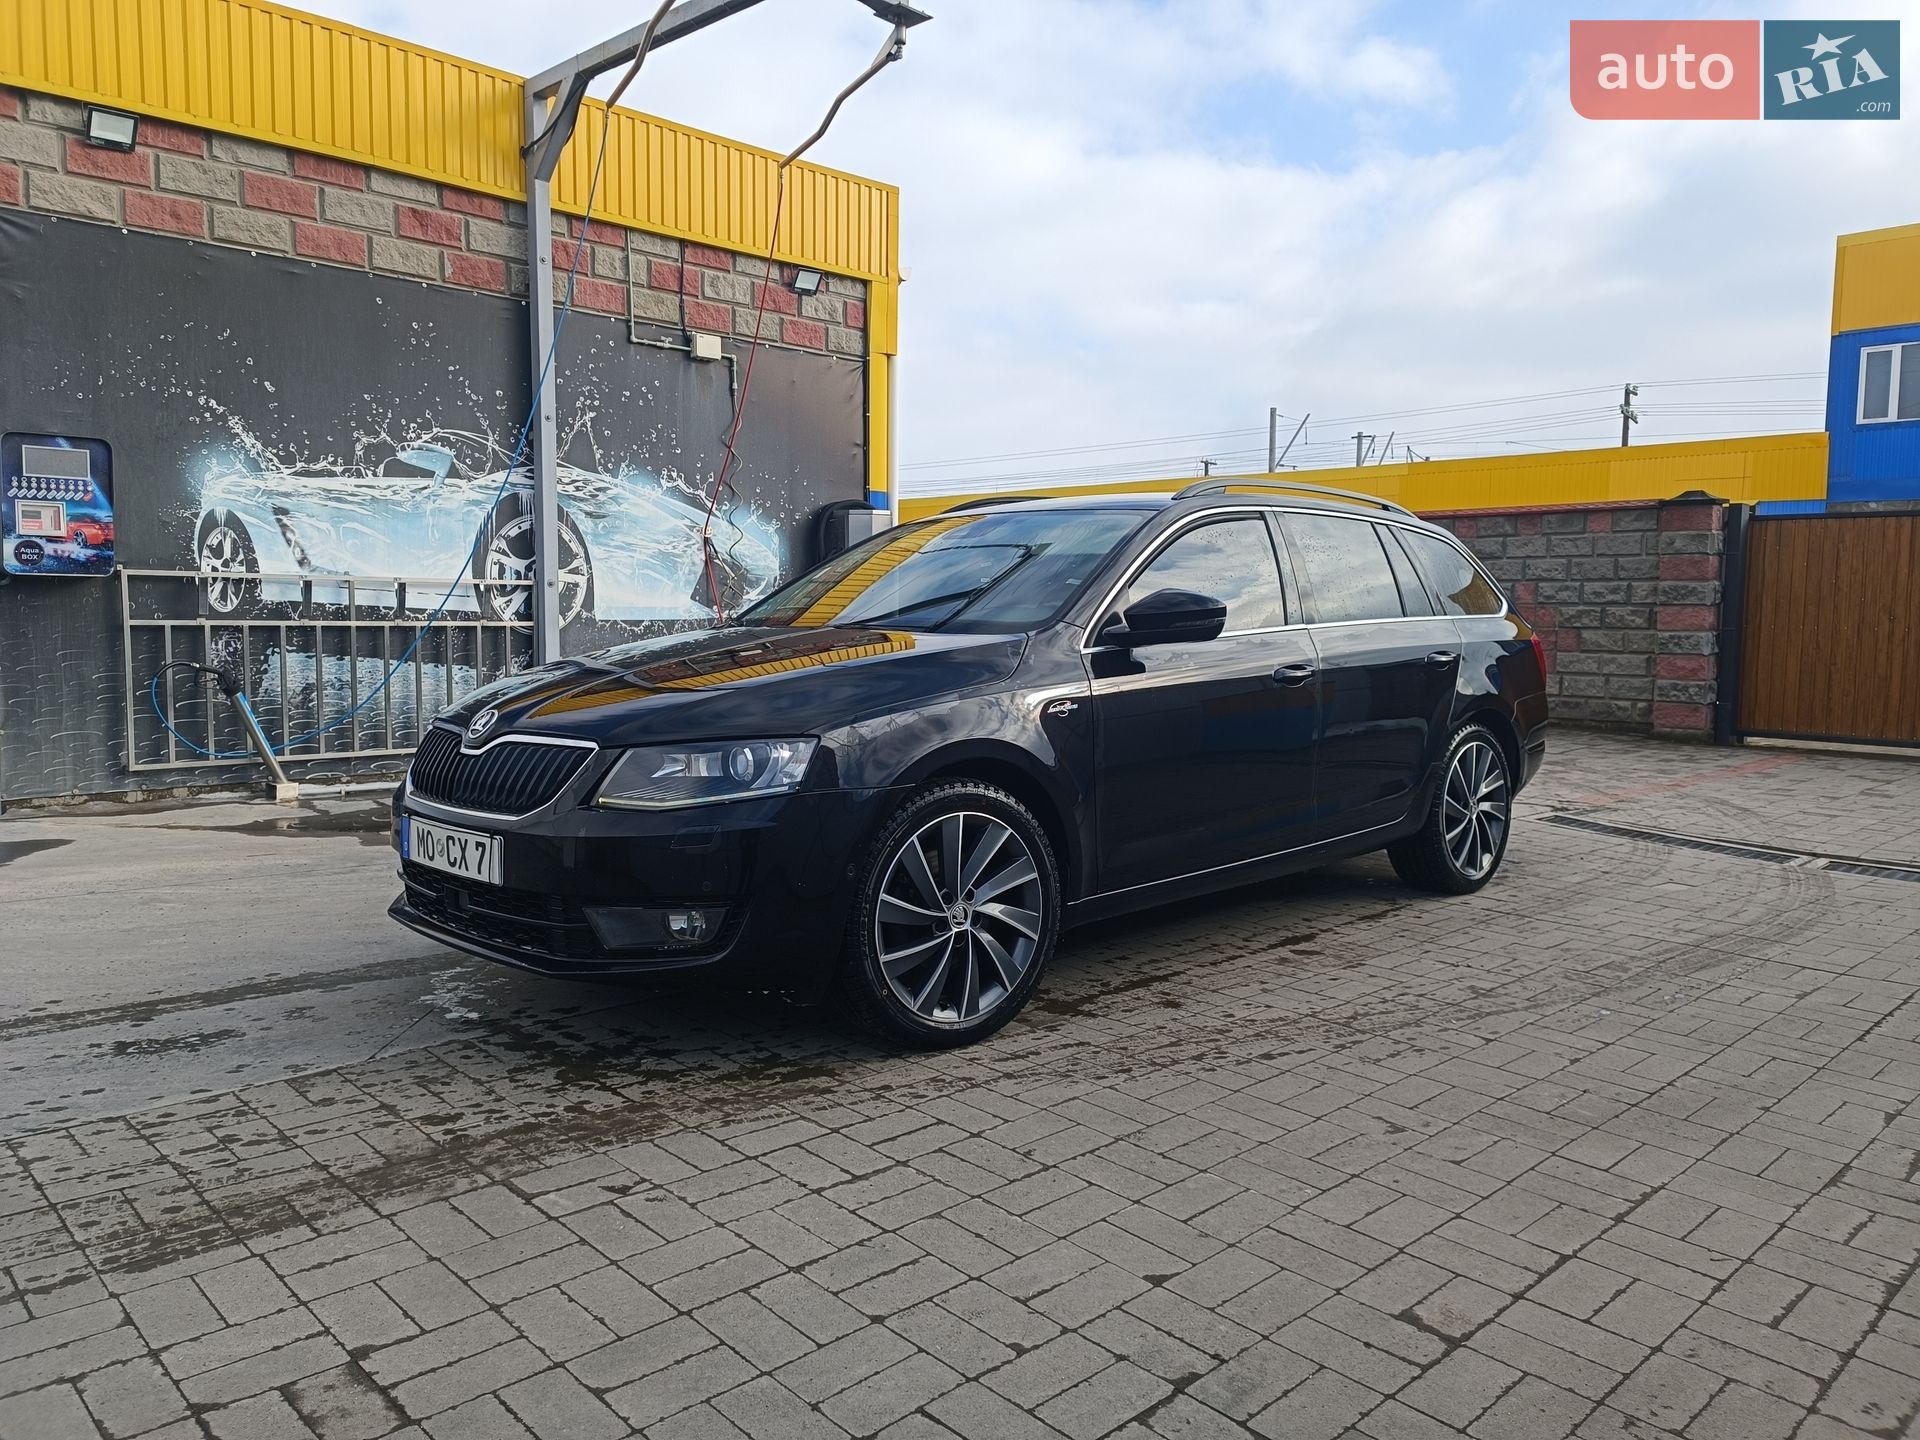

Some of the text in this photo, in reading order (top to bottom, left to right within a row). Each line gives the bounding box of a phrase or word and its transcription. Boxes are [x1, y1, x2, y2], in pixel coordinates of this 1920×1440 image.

[416, 826, 486, 875] MO CX 7
